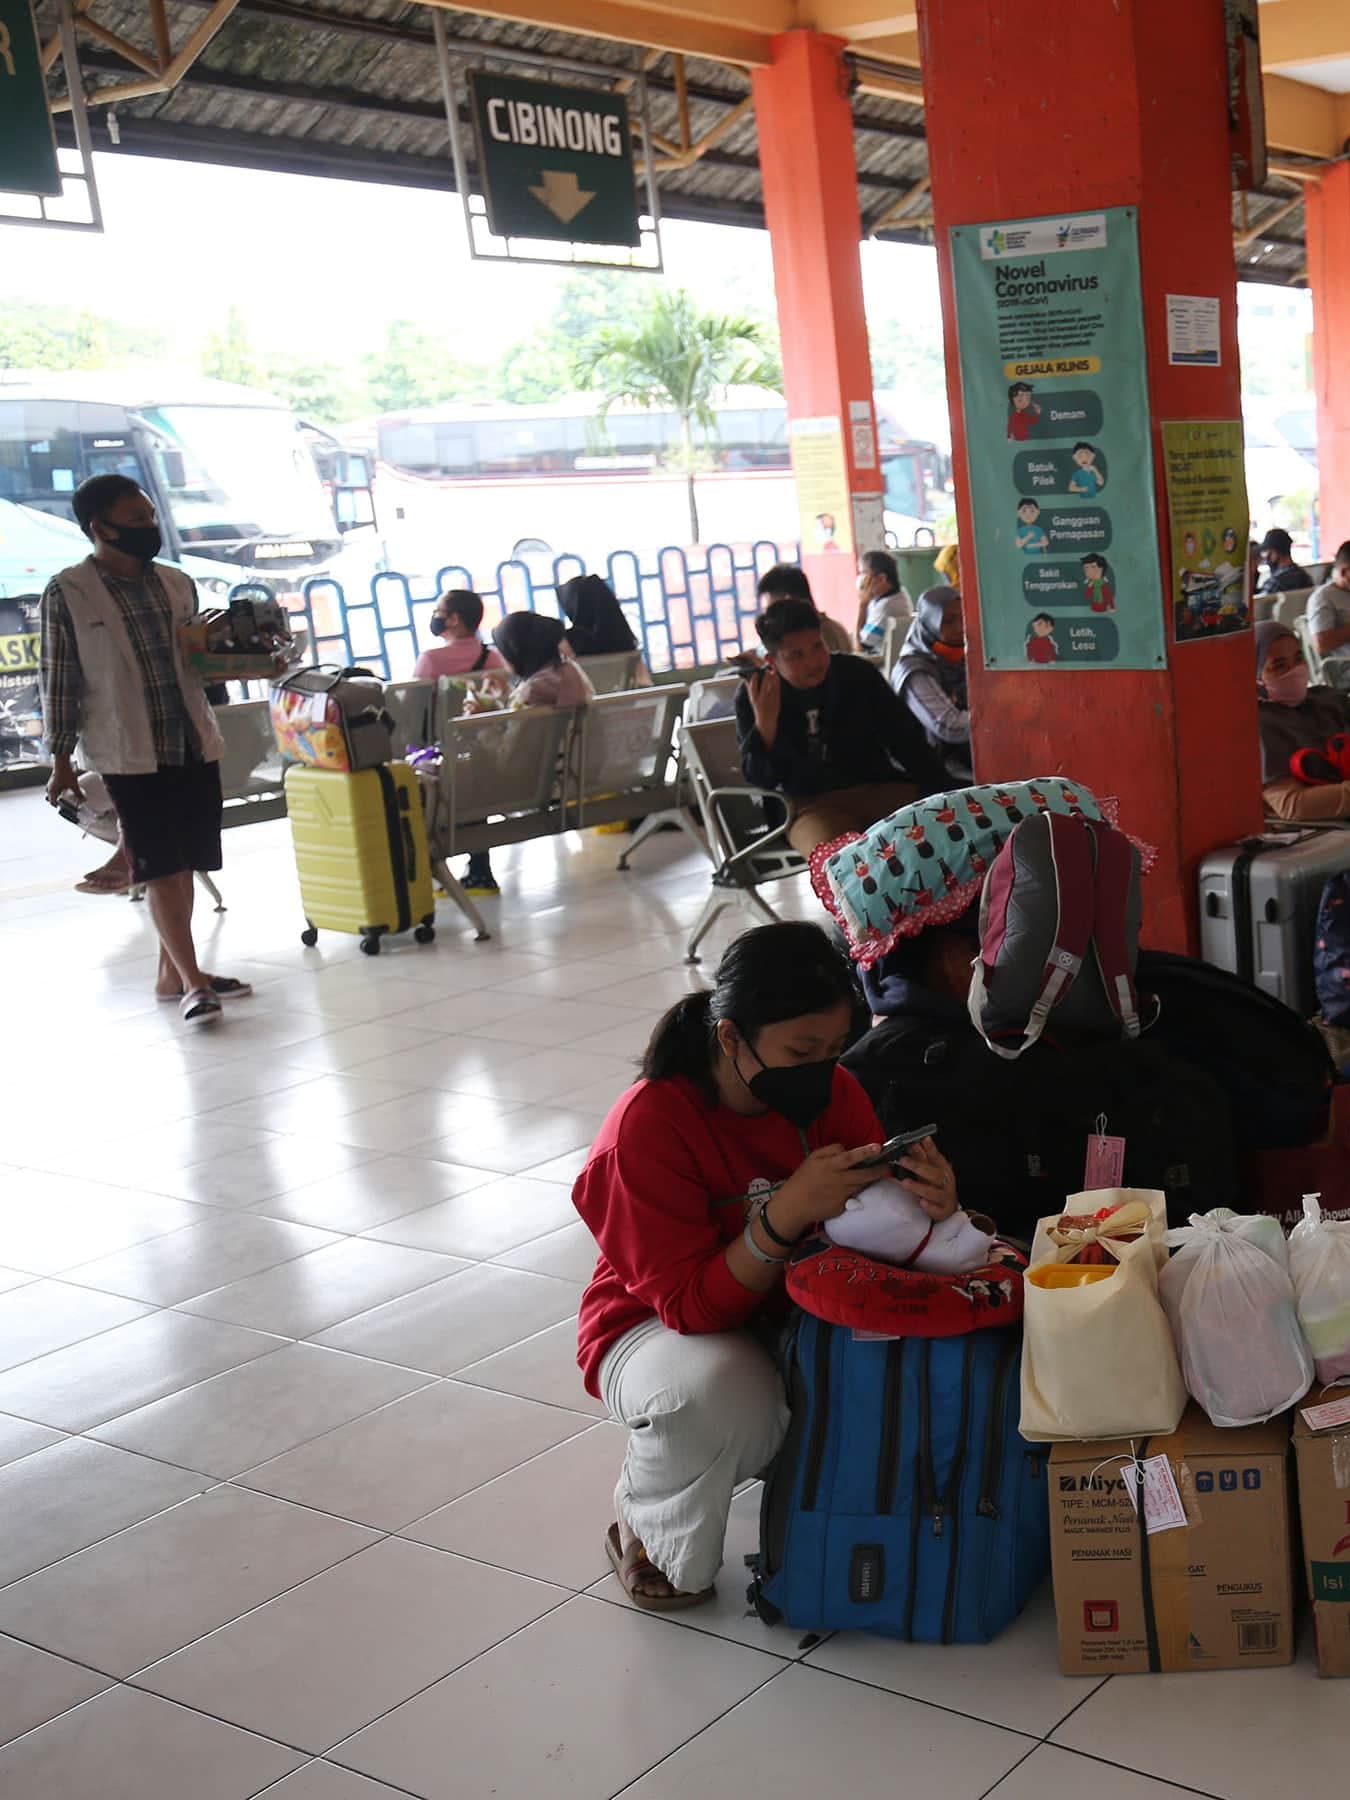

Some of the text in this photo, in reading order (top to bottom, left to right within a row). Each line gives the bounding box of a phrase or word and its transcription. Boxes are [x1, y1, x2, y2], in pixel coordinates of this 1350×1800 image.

[487, 98, 622, 156] CIBINONG
[995, 260, 1045, 281] Novel
[995, 274, 1099, 298] Coronavirus
[1015, 360, 1090, 376] GEJALA KLINIS
[1050, 410, 1086, 421] Demam
[1032, 475, 1056, 486] Pilek
[1052, 516, 1101, 528] Gangguan
[1038, 568, 1060, 578] Sakit
[1024, 580, 1078, 592] Tenggorokan
[1071, 641, 1096, 650] Lesu
[1062, 1499, 1084, 1509] TIPE
[1072, 1548, 1132, 1557] PENANAK NASI
[1216, 1582, 1263, 1593] PENGUKUS
